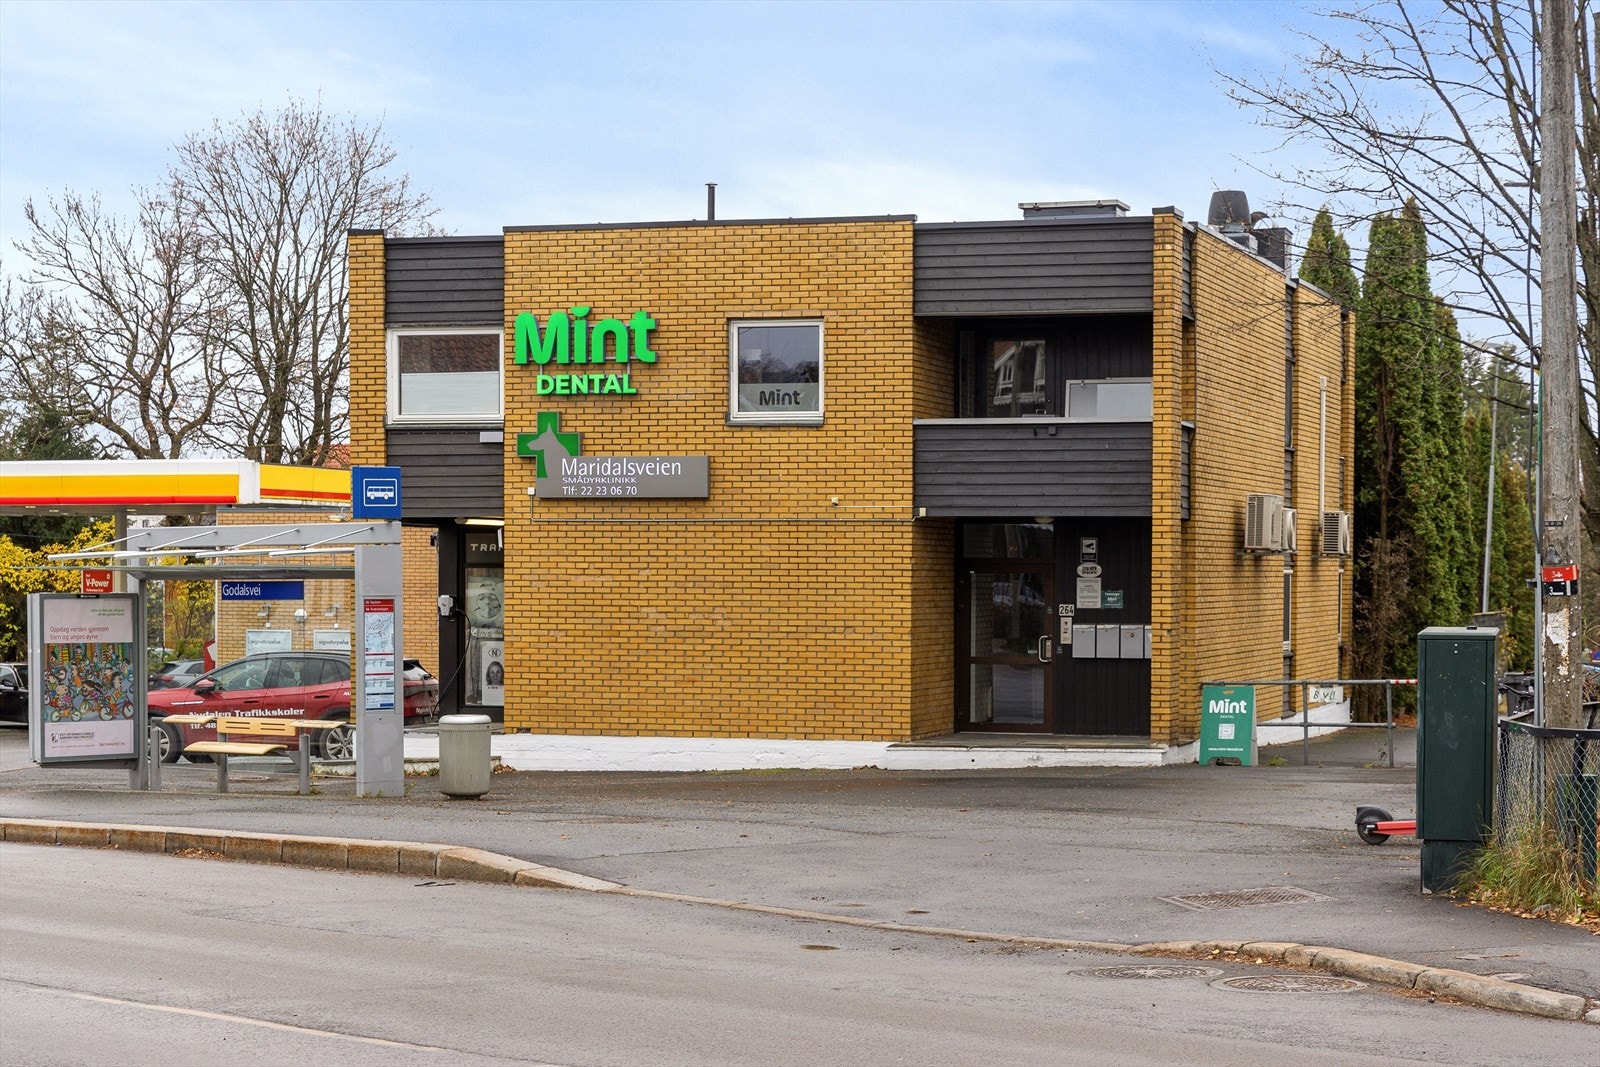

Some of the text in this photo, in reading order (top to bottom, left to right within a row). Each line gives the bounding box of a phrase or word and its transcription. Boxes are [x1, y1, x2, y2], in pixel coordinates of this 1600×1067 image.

[515, 306, 657, 364] Mint
[536, 373, 637, 395] DENTAL
[759, 389, 800, 406] Mint
[561, 458, 682, 476] Maridalsveien
[562, 476, 637, 484] SMÅDYRKLINIKK
[562, 486, 637, 496] Tlf: 22 23 06 70
[470, 543, 502, 552] TRA
[86, 578, 109, 587] V-Power
[222, 584, 261, 596] Godalsvei
[1060, 606, 1074, 614] 264
[1209, 698, 1247, 714] Mint
[234, 708, 305, 718] Trafikkskoler
